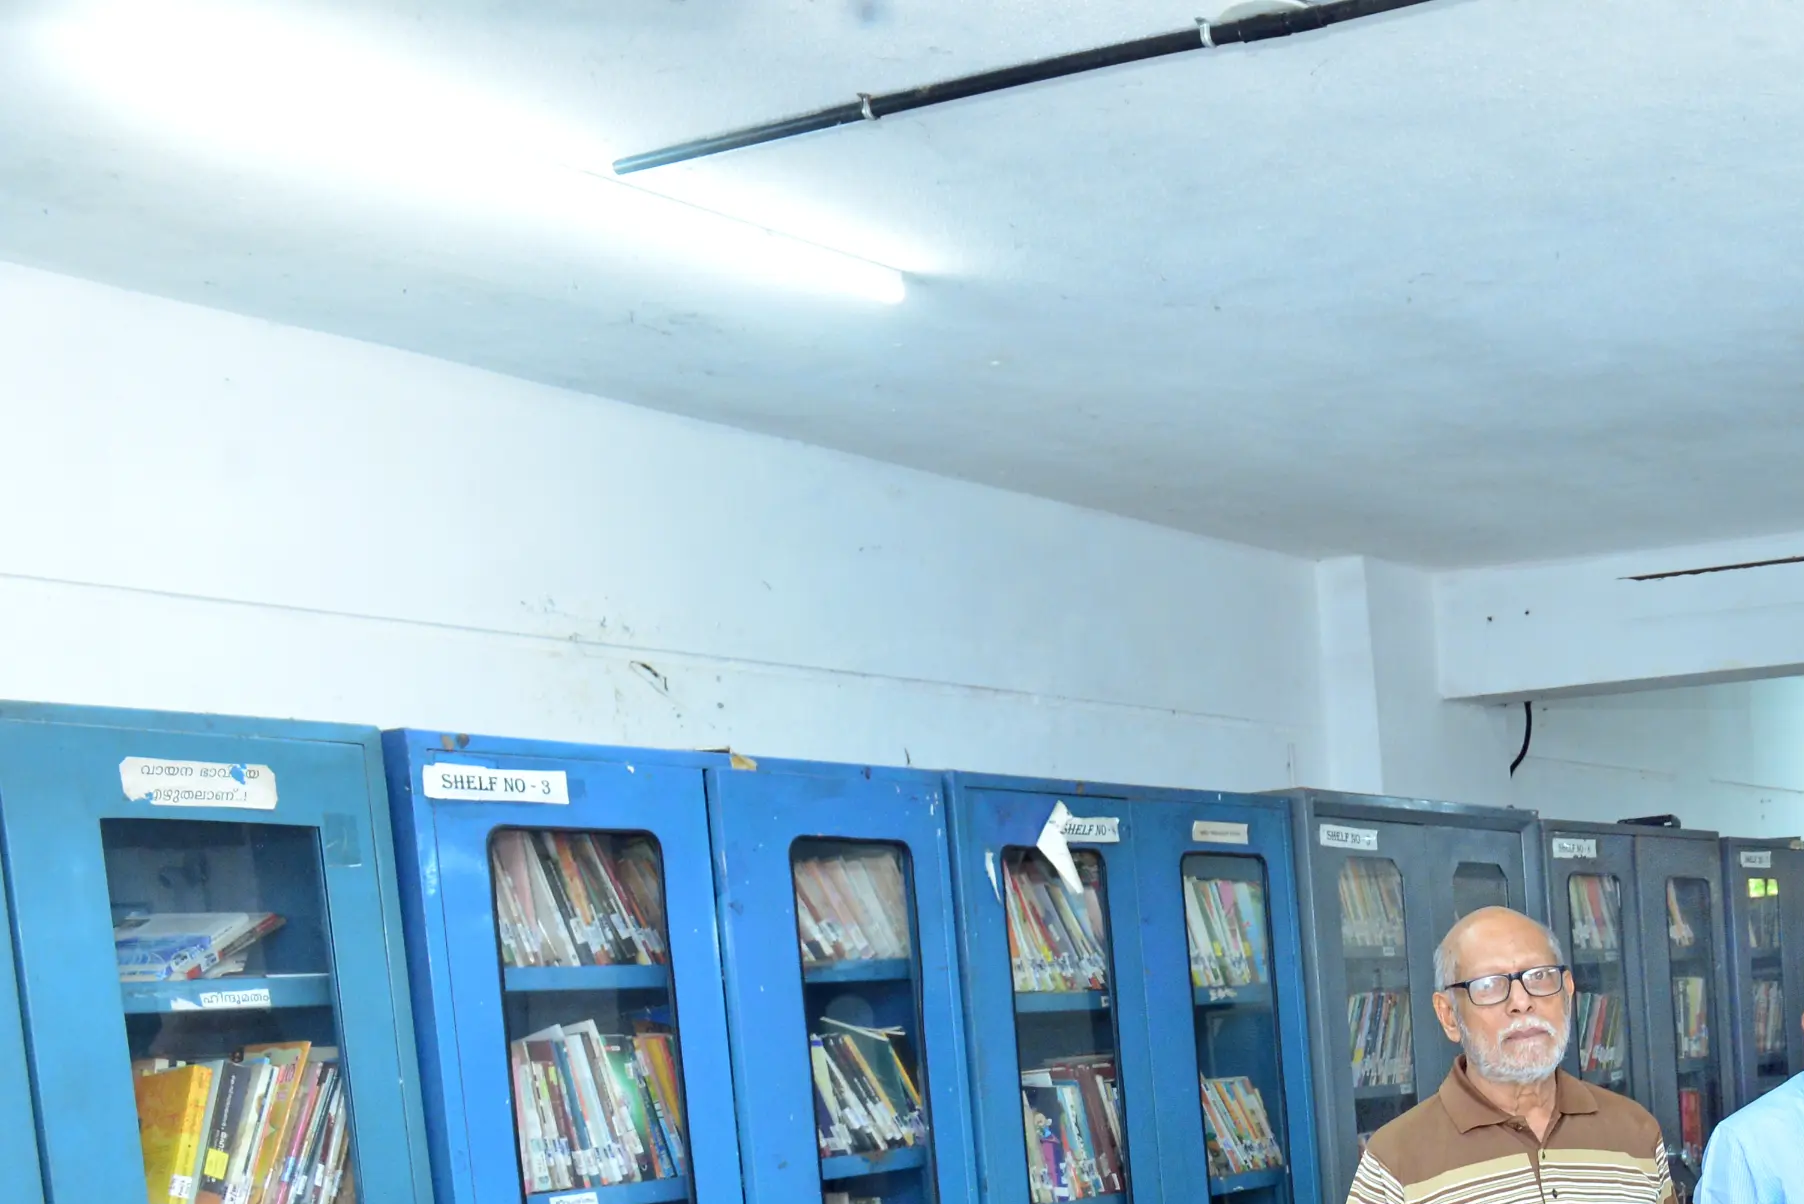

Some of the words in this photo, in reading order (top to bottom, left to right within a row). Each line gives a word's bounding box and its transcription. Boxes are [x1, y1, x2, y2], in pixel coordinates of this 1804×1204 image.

[141, 765, 193, 776] വായന
[441, 773, 498, 792] SHELF
[503, 777, 526, 793] NO
[541, 779, 552, 795] 3
[1060, 823, 1094, 836] SHELF
[1095, 825, 1107, 836] NO
[1326, 830, 1349, 842] SHELF
